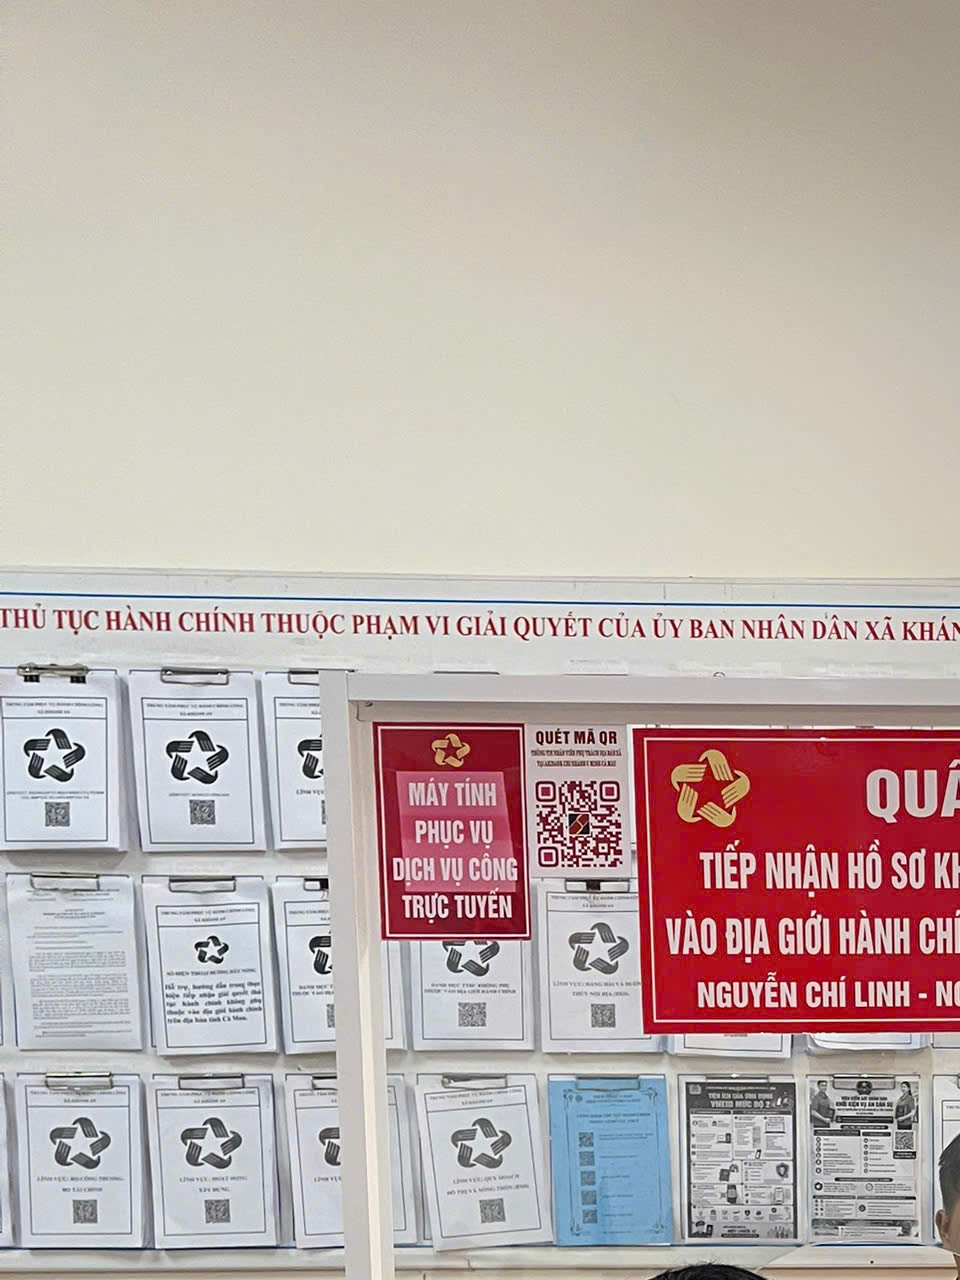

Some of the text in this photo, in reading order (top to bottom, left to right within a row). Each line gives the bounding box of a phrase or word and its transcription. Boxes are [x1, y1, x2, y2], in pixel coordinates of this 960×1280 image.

[0, 605, 46, 630] THỦ
[53, 608, 100, 636] TỤC
[106, 606, 172, 633] HÀNH
[178, 605, 256, 634] CHÍNH
[261, 608, 346, 641] THUỘC
[352, 614, 421, 641] PHẠM
[427, 614, 450, 637] VI
[456, 609, 508, 638] GIẢI
[513, 610, 593, 642] QUYẾT
[599, 612, 647, 639] CỦA
[653, 612, 684, 640] ỦY
[689, 618, 735, 640] BAN
[740, 613, 806, 641] NHÂN
[812, 616, 858, 641] DÂN
[864, 614, 896, 642] XÃ
[536, 728, 617, 746] QUÉT MÃ QR
[408, 778, 497, 806] MÁY TÍNH
[415, 820, 493, 849] PHỤC VỤ
[392, 853, 518, 886] DỊCH VỤ CÔNG
[699, 840, 757, 890] TIẾP
[765, 844, 838, 898] NHẬN
[847, 840, 880, 890] HỒ
[890, 847, 927, 890] SƠ
[402, 887, 513, 924] TRỰC TUYẾN
[666, 909, 718, 955] VÀO
[725, 917, 771, 963] ĐỊA
[778, 910, 830, 955] GIỚI
[838, 910, 911, 955] HÀNH
[697, 971, 798, 1008] NGUYỄN
[805, 975, 847, 1008] CHÍ
[854, 981, 911, 1007] LINH
